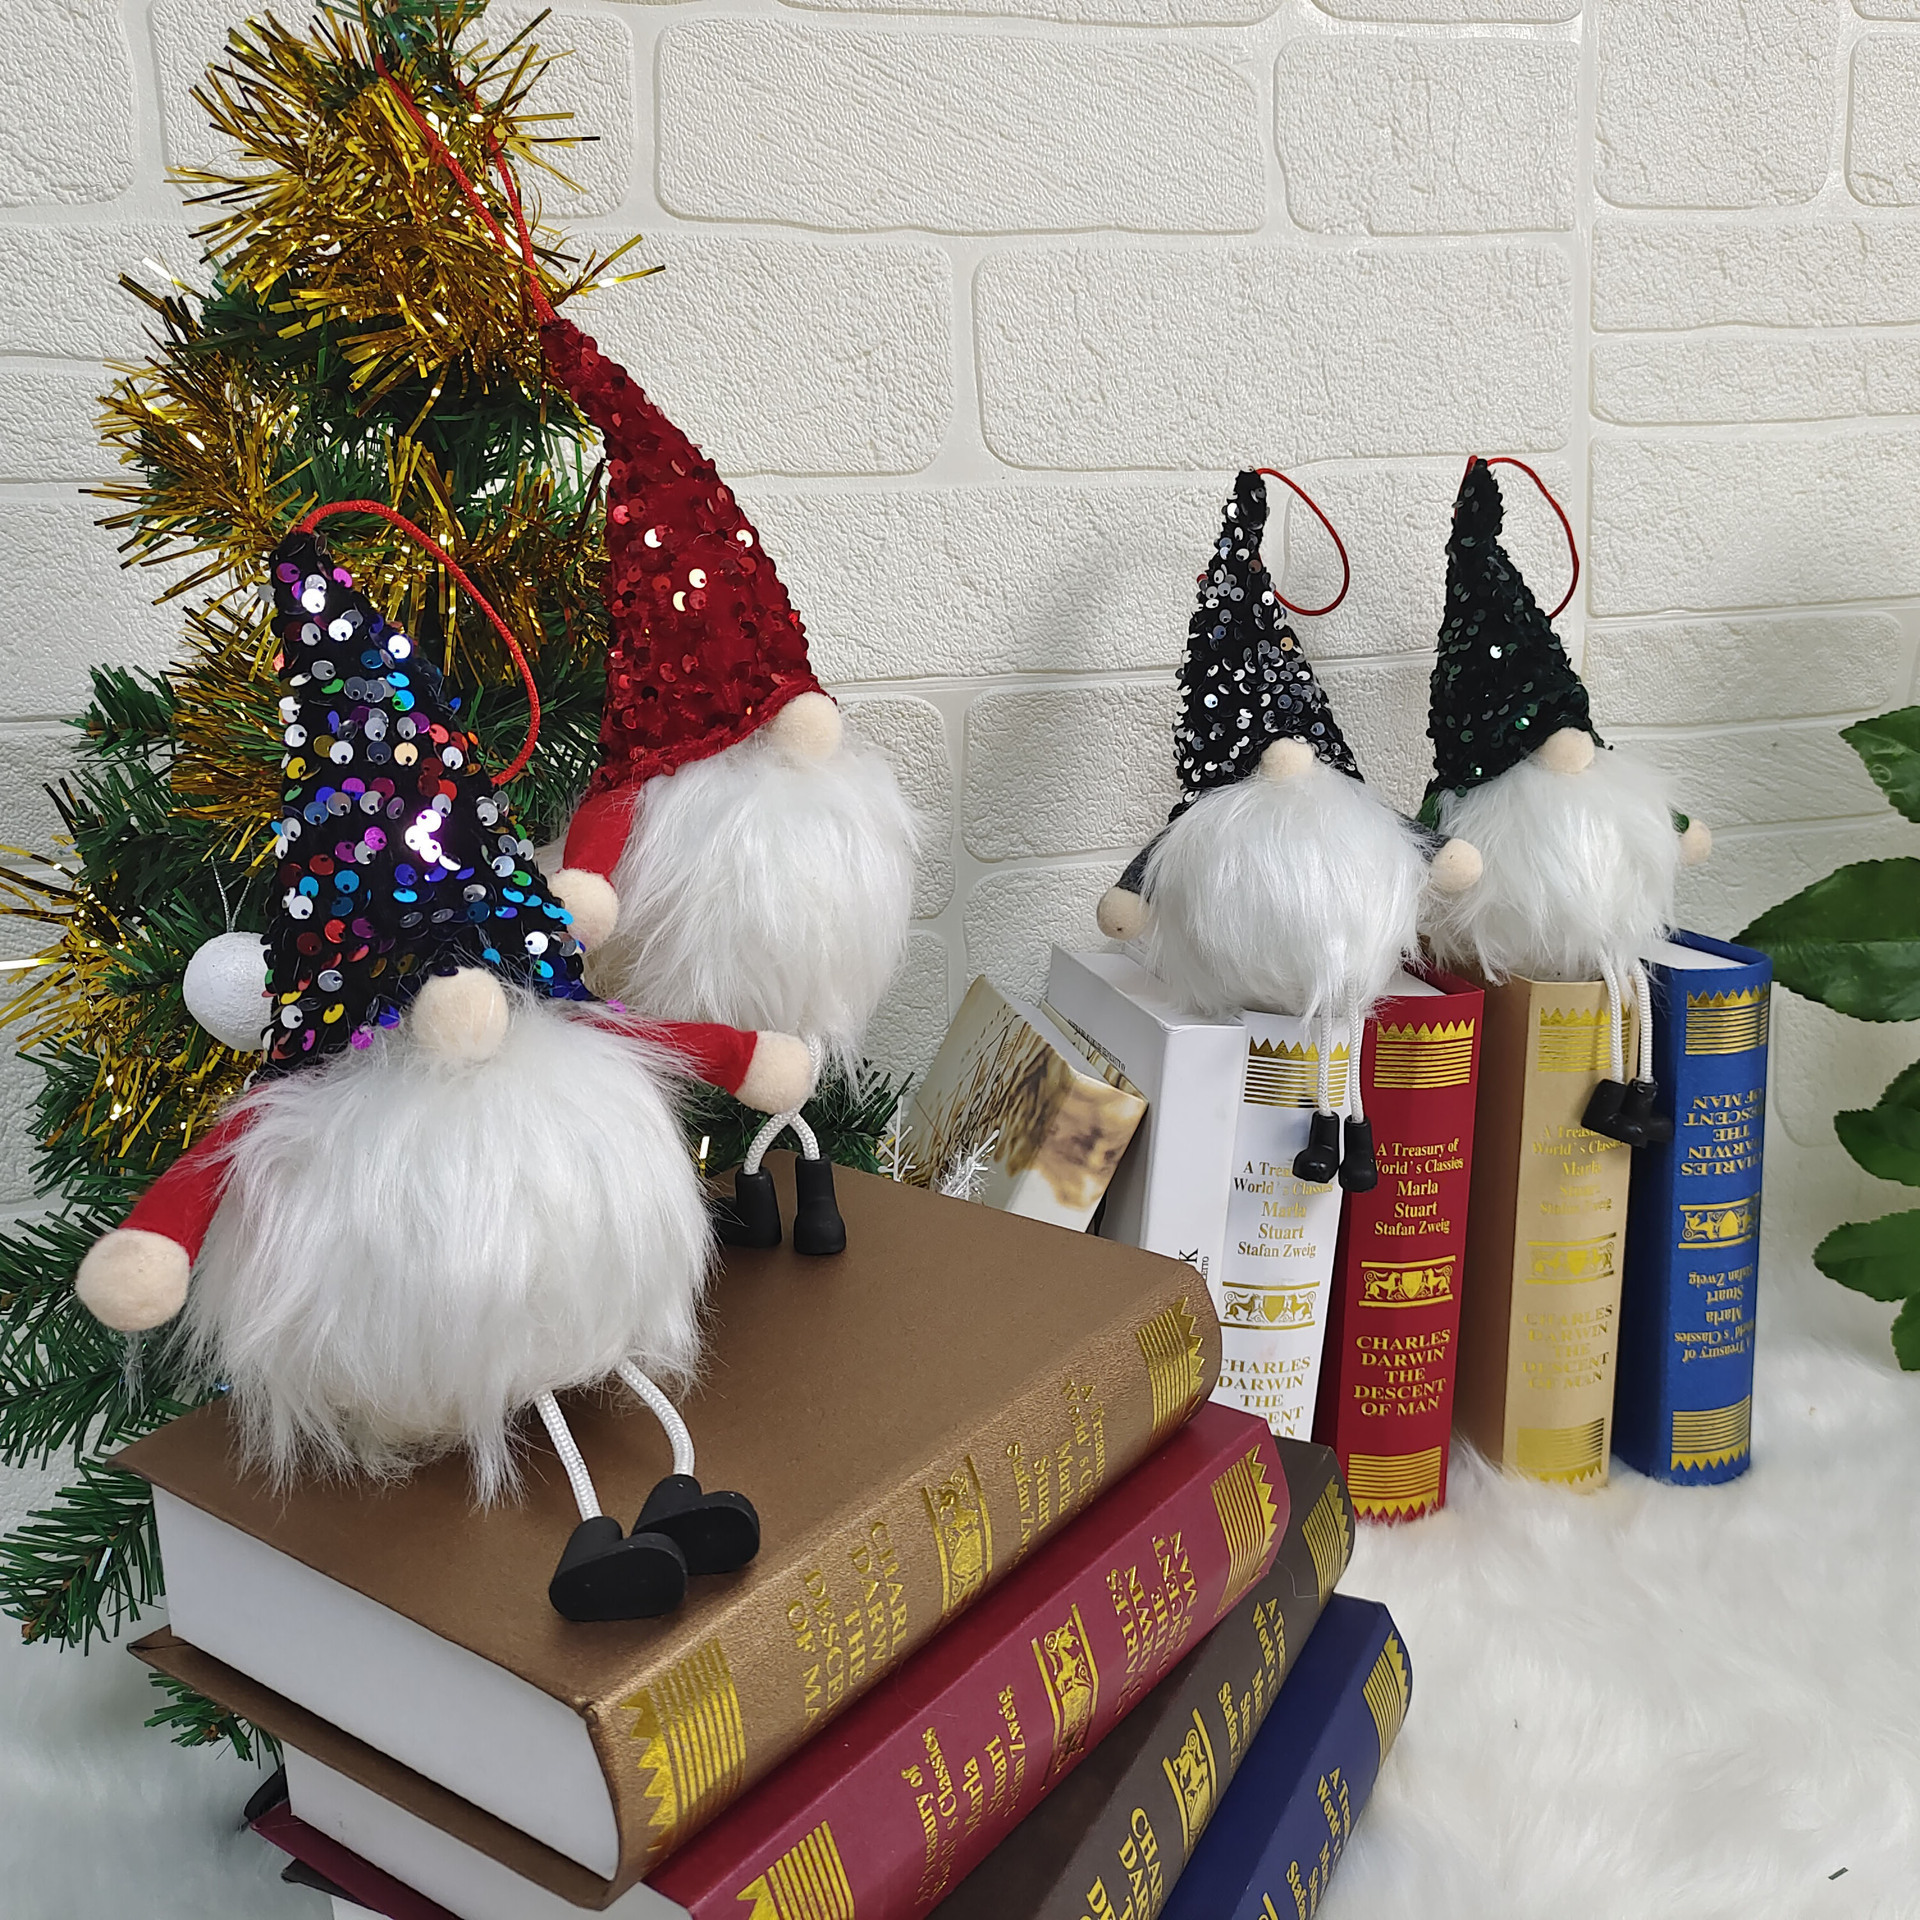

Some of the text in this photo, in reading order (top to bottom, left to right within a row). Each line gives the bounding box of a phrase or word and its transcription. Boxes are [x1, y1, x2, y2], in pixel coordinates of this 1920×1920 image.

[1692, 1092, 1743, 1109] MAN
[1712, 1124, 1750, 1142] THE
[1376, 1138, 1460, 1158] A Treasury of
[1243, 1160, 1254, 1174] A
[1396, 1179, 1439, 1196] Marla
[1261, 1200, 1308, 1218] Marla
[1394, 1201, 1438, 1218] Stuart
[1258, 1222, 1305, 1240] Stuart
[1374, 1218, 1451, 1236] Stafan Zweig
[1237, 1241, 1317, 1259] Stafan Zweig
[1688, 1271, 1726, 1289] Zweig
[1706, 1285, 1744, 1305] Stuart
[1705, 1305, 1743, 1326] Marla
[1356, 1328, 1452, 1351] CHARLES
[1699, 1340, 1745, 1359] Treasury
[1361, 1346, 1446, 1368] DARWIN
[1682, 1348, 1697, 1363] of
[1218, 1373, 1305, 1391] DARWIN
[1384, 1367, 1426, 1384] THE
[1353, 1378, 1447, 1400] DESCENT
[1240, 1394, 1284, 1408] THE
[1361, 1395, 1440, 1417] OF MAN
[1055, 1439, 1075, 1516] Marla
[1170, 1529, 1198, 1611] MAN
[1266, 1598, 1278, 1619] A
[787, 1600, 816, 1653] OF
[1151, 1586, 1169, 1655] THE
[844, 1601, 867, 1687] THE
[998, 1684, 1026, 1758] Zweig
[1217, 1681, 1239, 1751] Stafan
[901, 1764, 923, 1788] of
[983, 1735, 1008, 1815] Stuart
[1329, 1767, 1341, 1790] A
[963, 1757, 984, 1840] Marla
